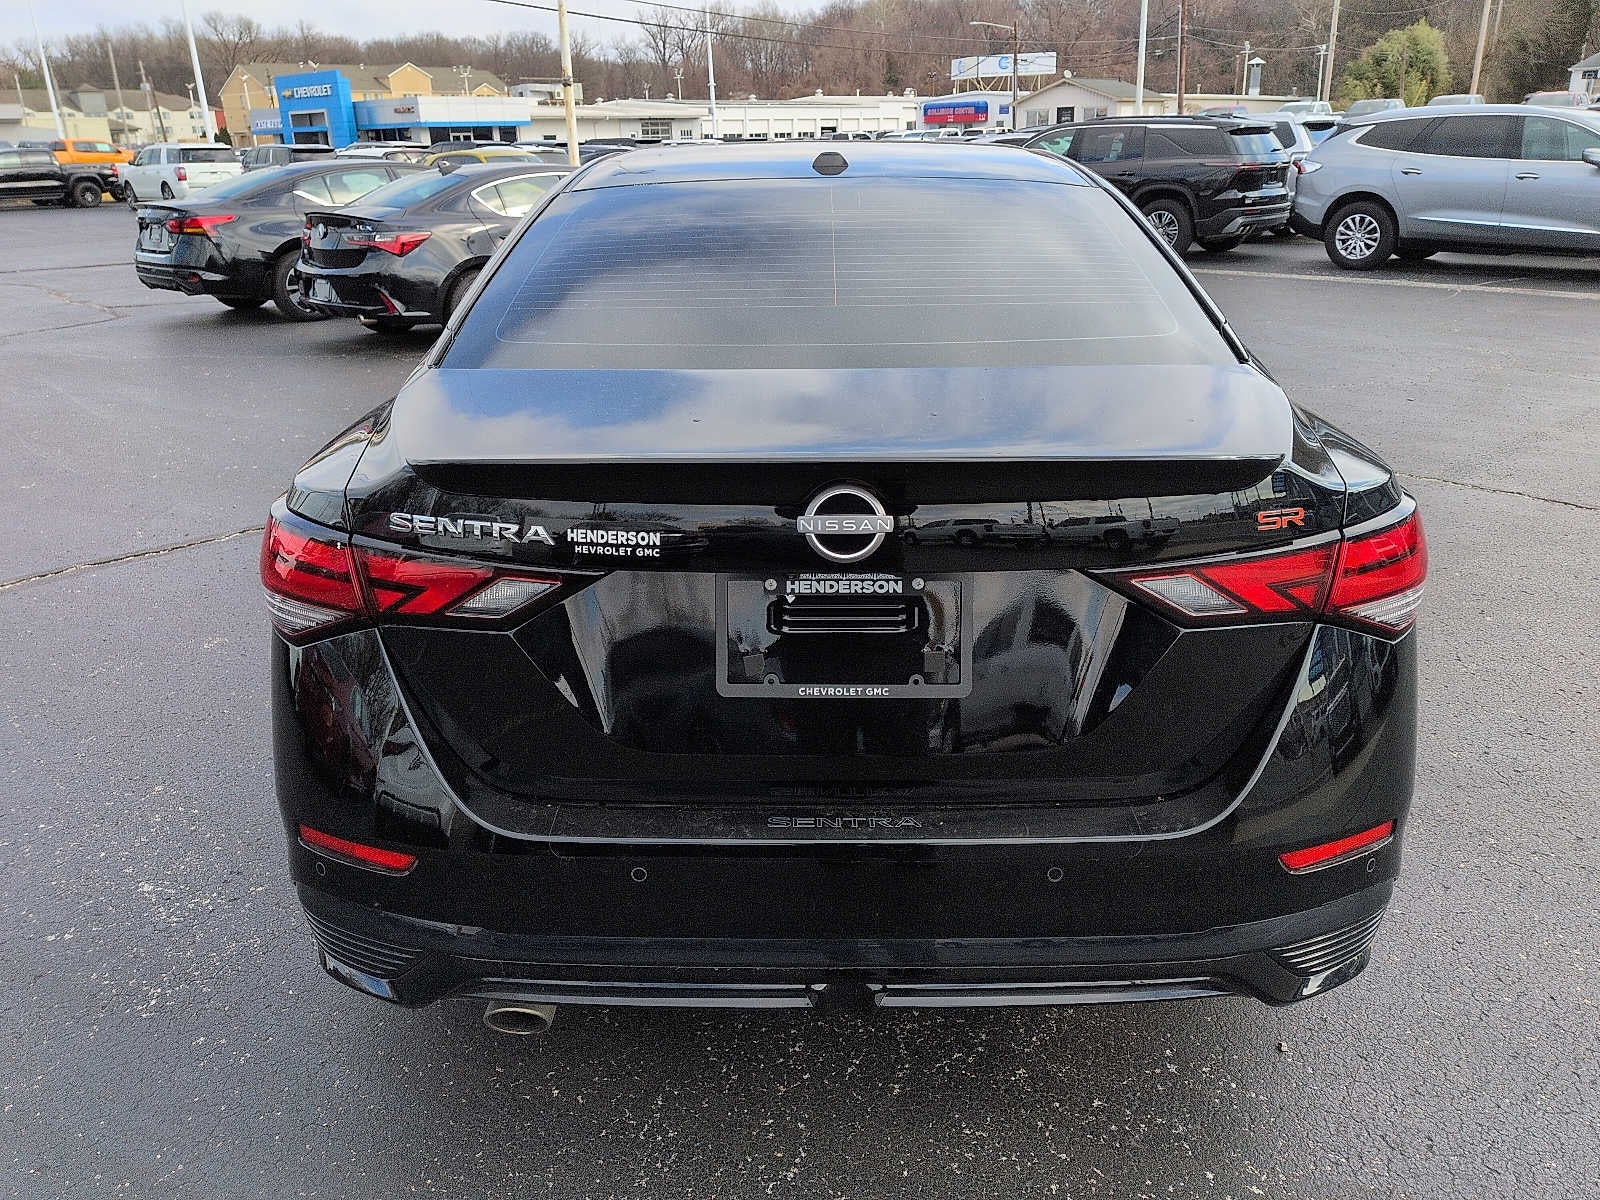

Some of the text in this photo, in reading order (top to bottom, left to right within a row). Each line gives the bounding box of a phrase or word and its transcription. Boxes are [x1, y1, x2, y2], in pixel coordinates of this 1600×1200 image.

[294, 85, 332, 98] CHEVROLET
[800, 519, 891, 531] NISSAN
[1258, 508, 1304, 530] SR
[389, 511, 556, 546] SENTRA
[567, 529, 660, 546] HENDERSON
[574, 544, 661, 557] HEVROLET GMC
[786, 580, 903, 594] HENDERSON
[798, 686, 890, 696] CHEVROLET GMC
[767, 816, 923, 829] SENTRA
